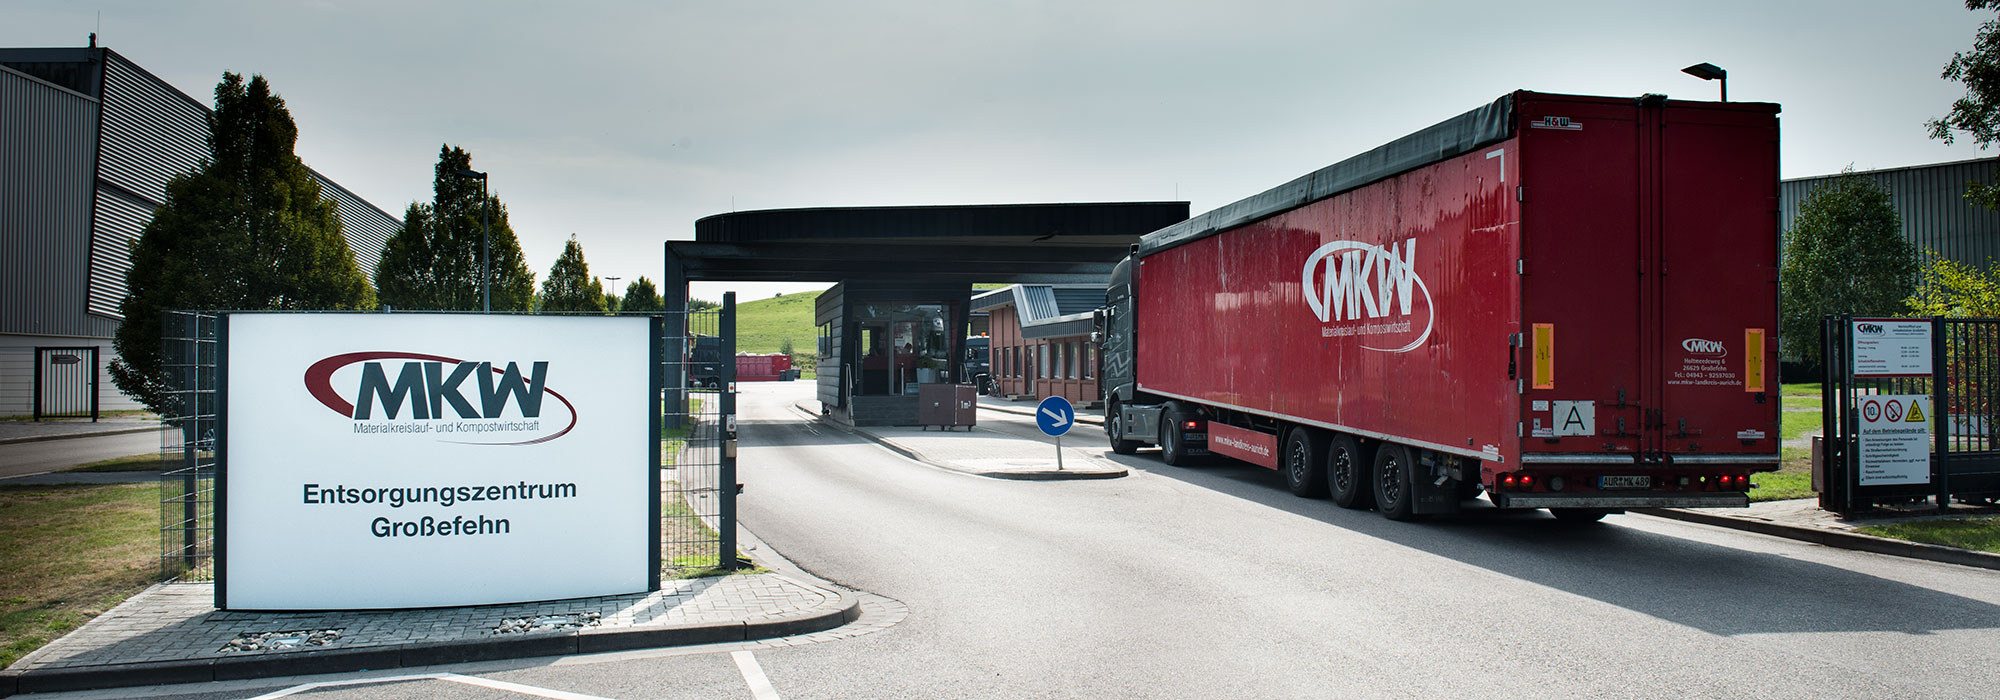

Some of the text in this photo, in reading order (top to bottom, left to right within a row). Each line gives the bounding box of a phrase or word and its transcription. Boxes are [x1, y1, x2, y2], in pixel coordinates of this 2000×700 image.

[1544, 116, 1570, 127] H&W
[1322, 238, 1417, 323] MKW
[1357, 323, 1367, 335] und
[1863, 324, 1884, 334] MKW
[1690, 340, 1723, 353] MKW
[353, 361, 549, 420] MKW
[1866, 406, 1876, 416] 10
[1562, 405, 1586, 431] A
[353, 420, 540, 434] Materialkreislauf- und Kompostwirtschaft
[1603, 476, 1619, 487] AUR
[303, 481, 577, 508] Entsorgungszentrum
[371, 515, 510, 538] Großefehn
